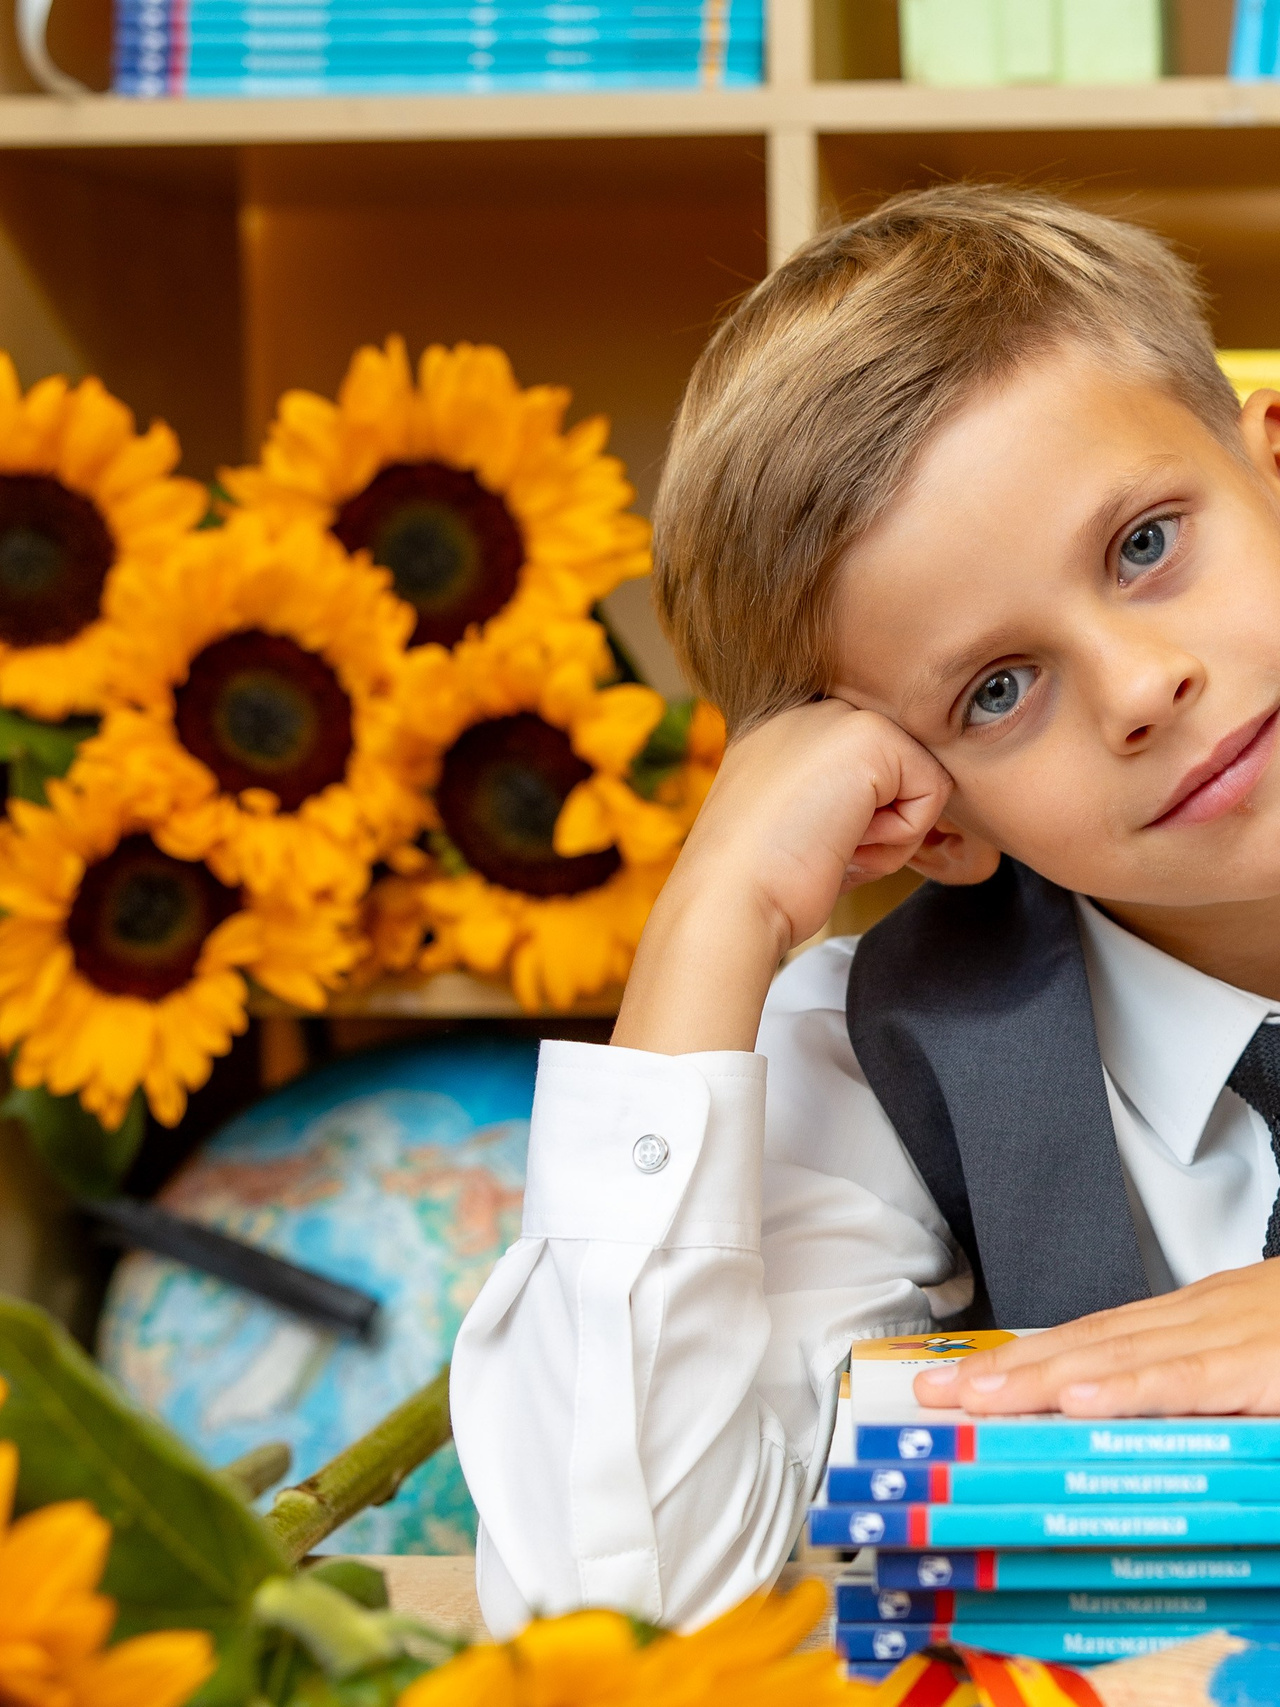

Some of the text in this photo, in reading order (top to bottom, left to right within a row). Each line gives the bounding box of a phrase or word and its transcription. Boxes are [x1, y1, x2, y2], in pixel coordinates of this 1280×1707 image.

[1090, 1430, 1231, 1452] Математика
[1065, 1471, 1208, 1494] Математика
[1044, 1513, 1188, 1536] Математика
[1111, 1556, 1251, 1579] Математика
[1069, 1592, 1208, 1613] Математика
